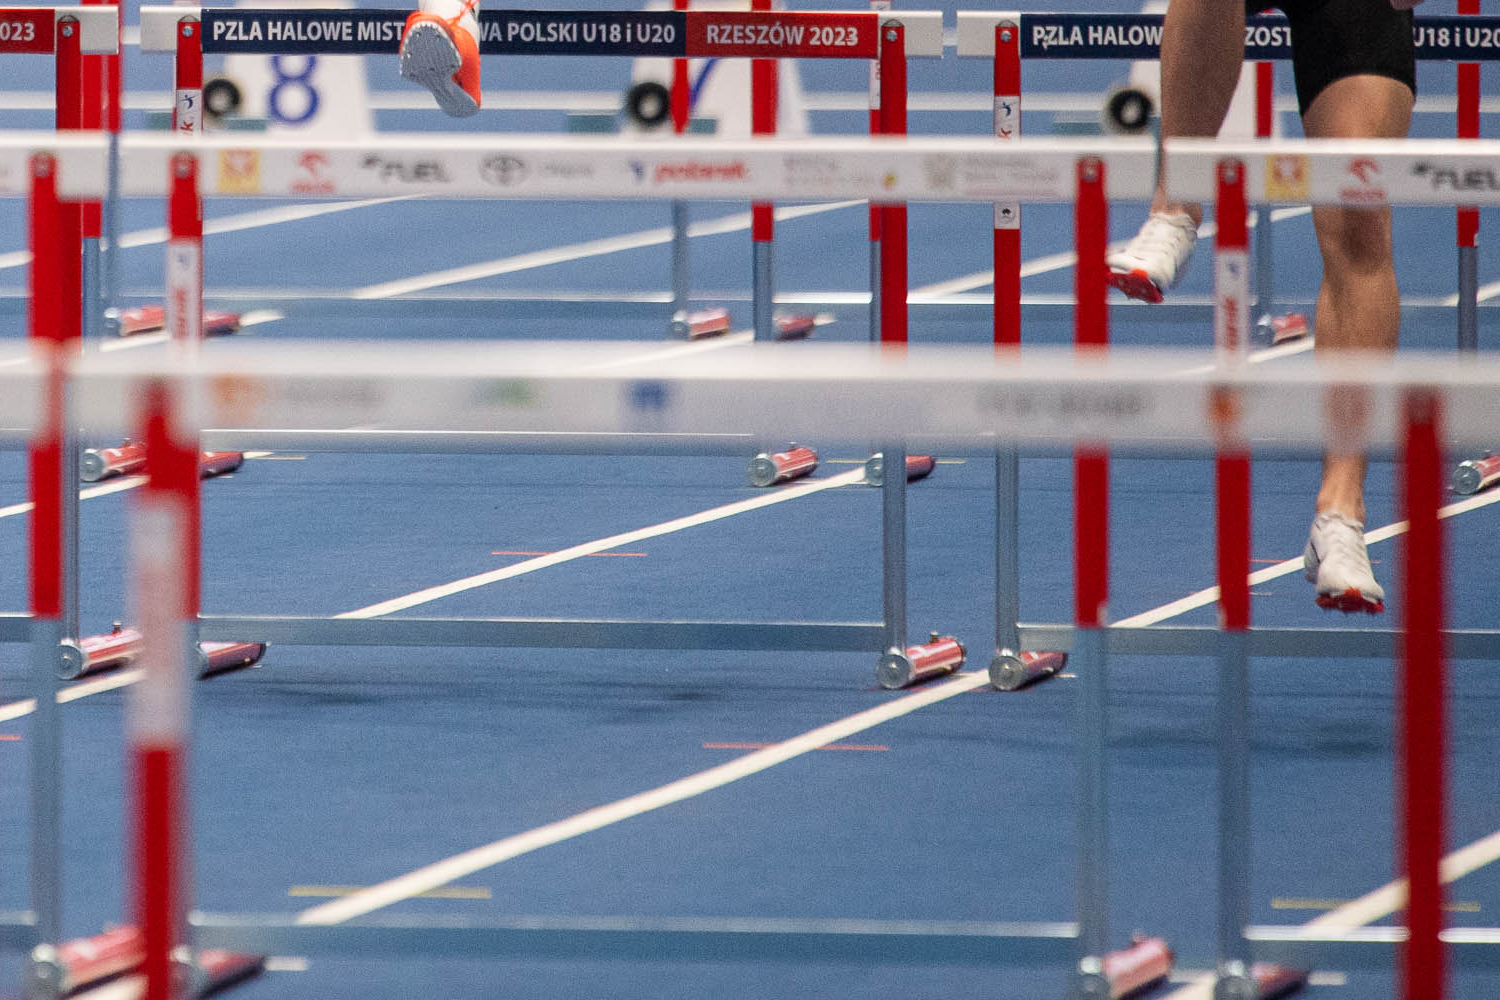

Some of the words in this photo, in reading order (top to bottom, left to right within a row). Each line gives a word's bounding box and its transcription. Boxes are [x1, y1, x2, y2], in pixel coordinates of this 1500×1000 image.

[213, 21, 263, 41] PZLA
[267, 21, 353, 41] HALOWE
[507, 22, 578, 43] POLSKI
[582, 23, 622, 43] U18
[625, 23, 632, 43] i
[636, 24, 676, 43] U20
[707, 21, 804, 45] RZESZÓW
[809, 25, 858, 46] 2023
[1032, 26, 1084, 47] PZLA
[1088, 26, 1164, 46] HALOW
[1412, 27, 1450, 48] U18
[1454, 27, 1461, 48] i
